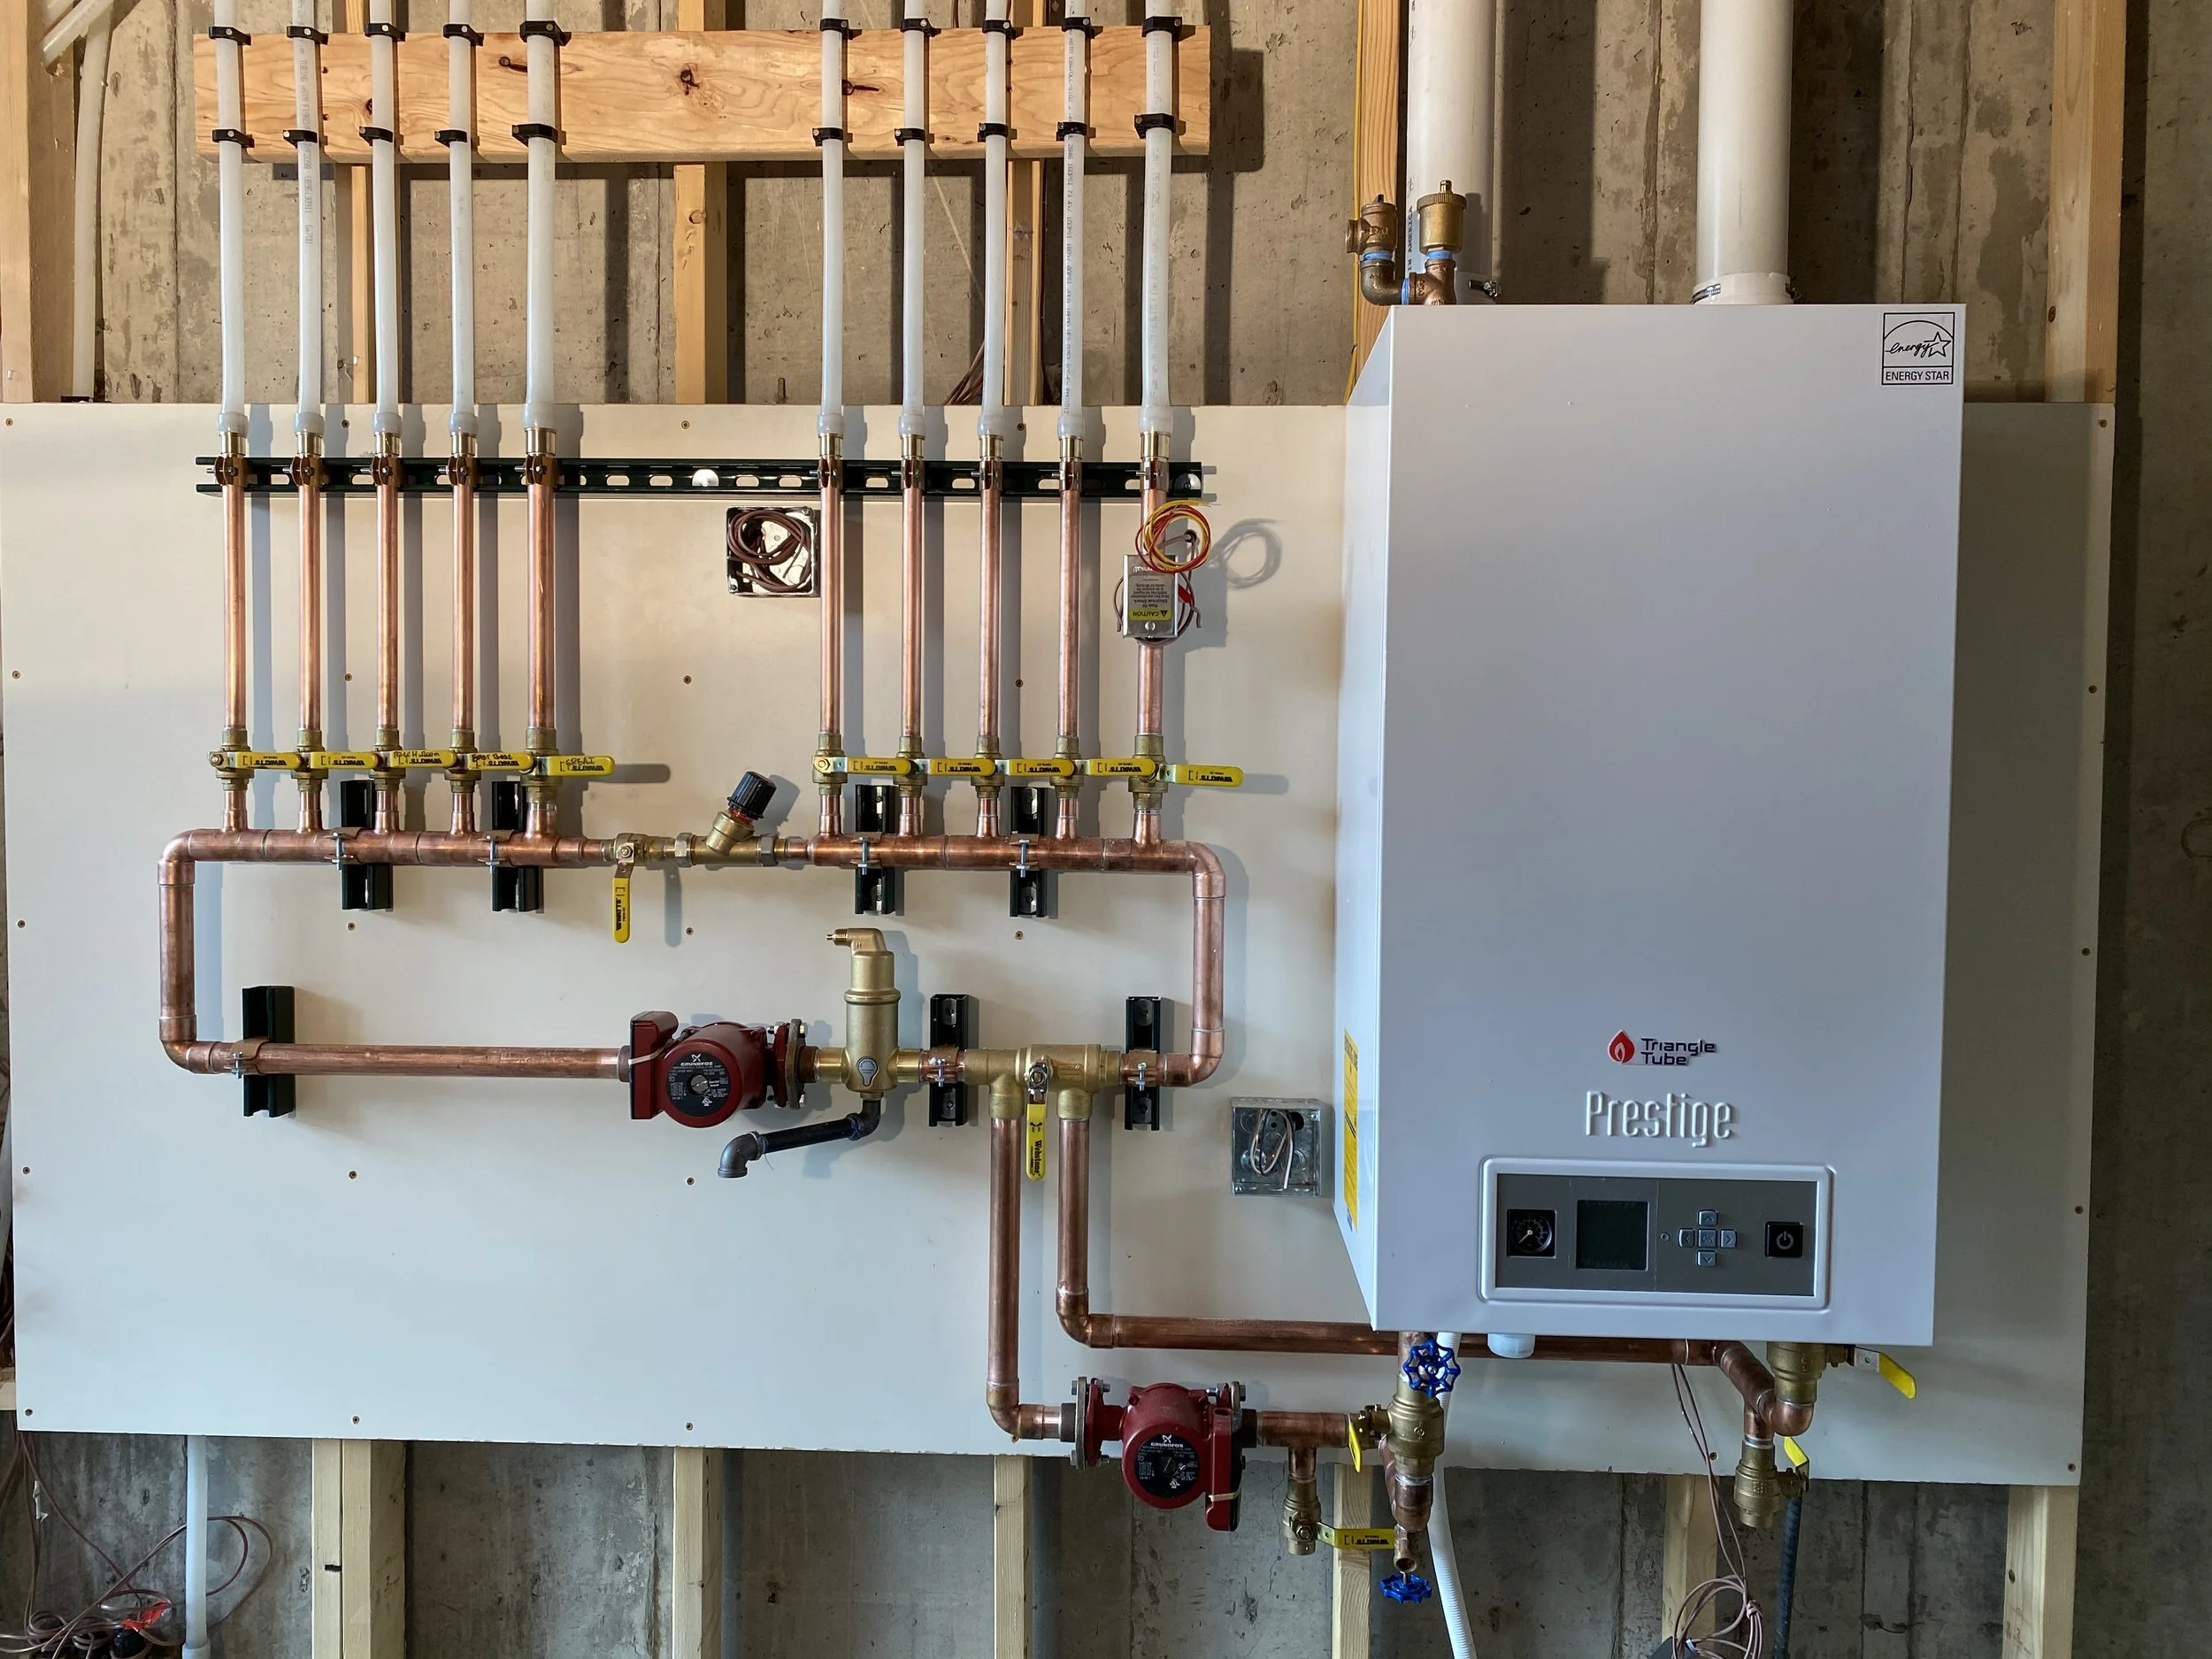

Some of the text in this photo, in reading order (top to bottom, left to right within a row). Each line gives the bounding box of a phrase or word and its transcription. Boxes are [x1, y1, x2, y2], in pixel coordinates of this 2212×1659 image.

[1407, 258, 1413, 272] IN
[1886, 342, 1939, 358] energy
[1886, 371, 1950, 381] ENERGY STAR
[1640, 1038, 1717, 1058] Triangle
[1640, 1051, 1687, 1066] Tube
[1585, 1090, 1735, 1148] Prestige
[1033, 1139, 1042, 1175] Webstone
[1701, 1234, 1713, 1243] OK
